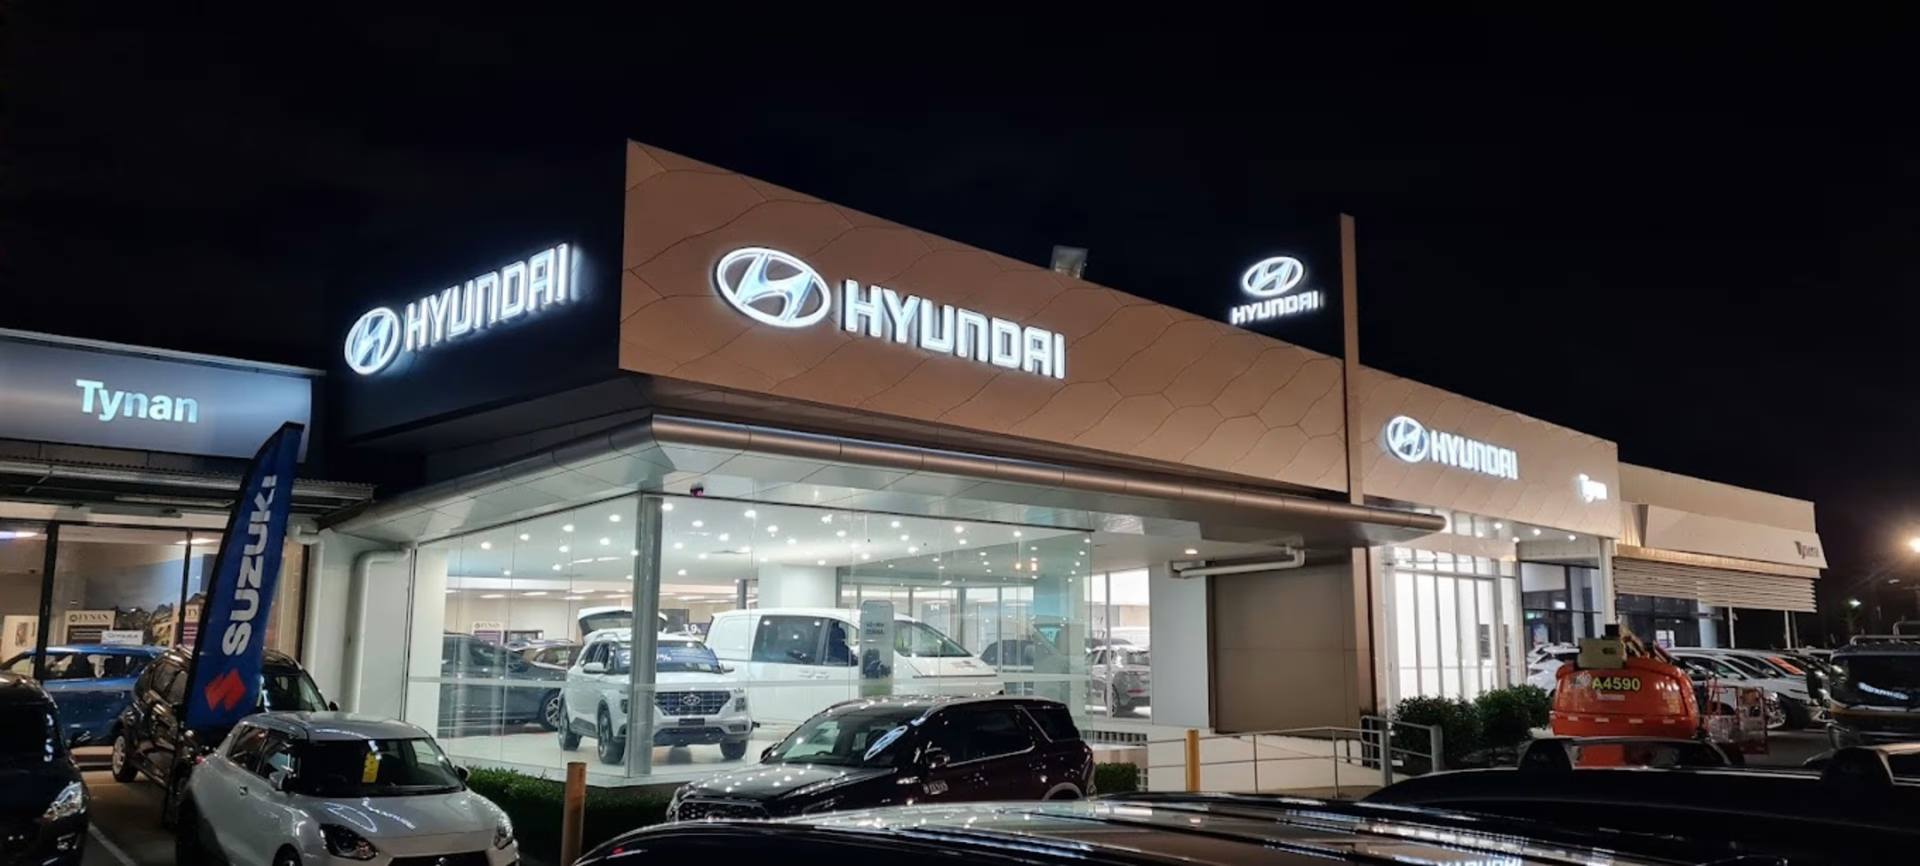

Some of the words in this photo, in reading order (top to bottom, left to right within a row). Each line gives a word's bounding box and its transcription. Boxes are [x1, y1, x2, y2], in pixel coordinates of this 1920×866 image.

[404, 243, 569, 351] HYUNDAI
[1231, 290, 1319, 325] HYUNDAI
[844, 278, 1066, 380] HYUNDAI
[76, 379, 198, 423] Tynan
[1430, 429, 1518, 480] HYUNDAI
[222, 474, 277, 656] SUZUKI
[1591, 677, 1642, 692] A4590
